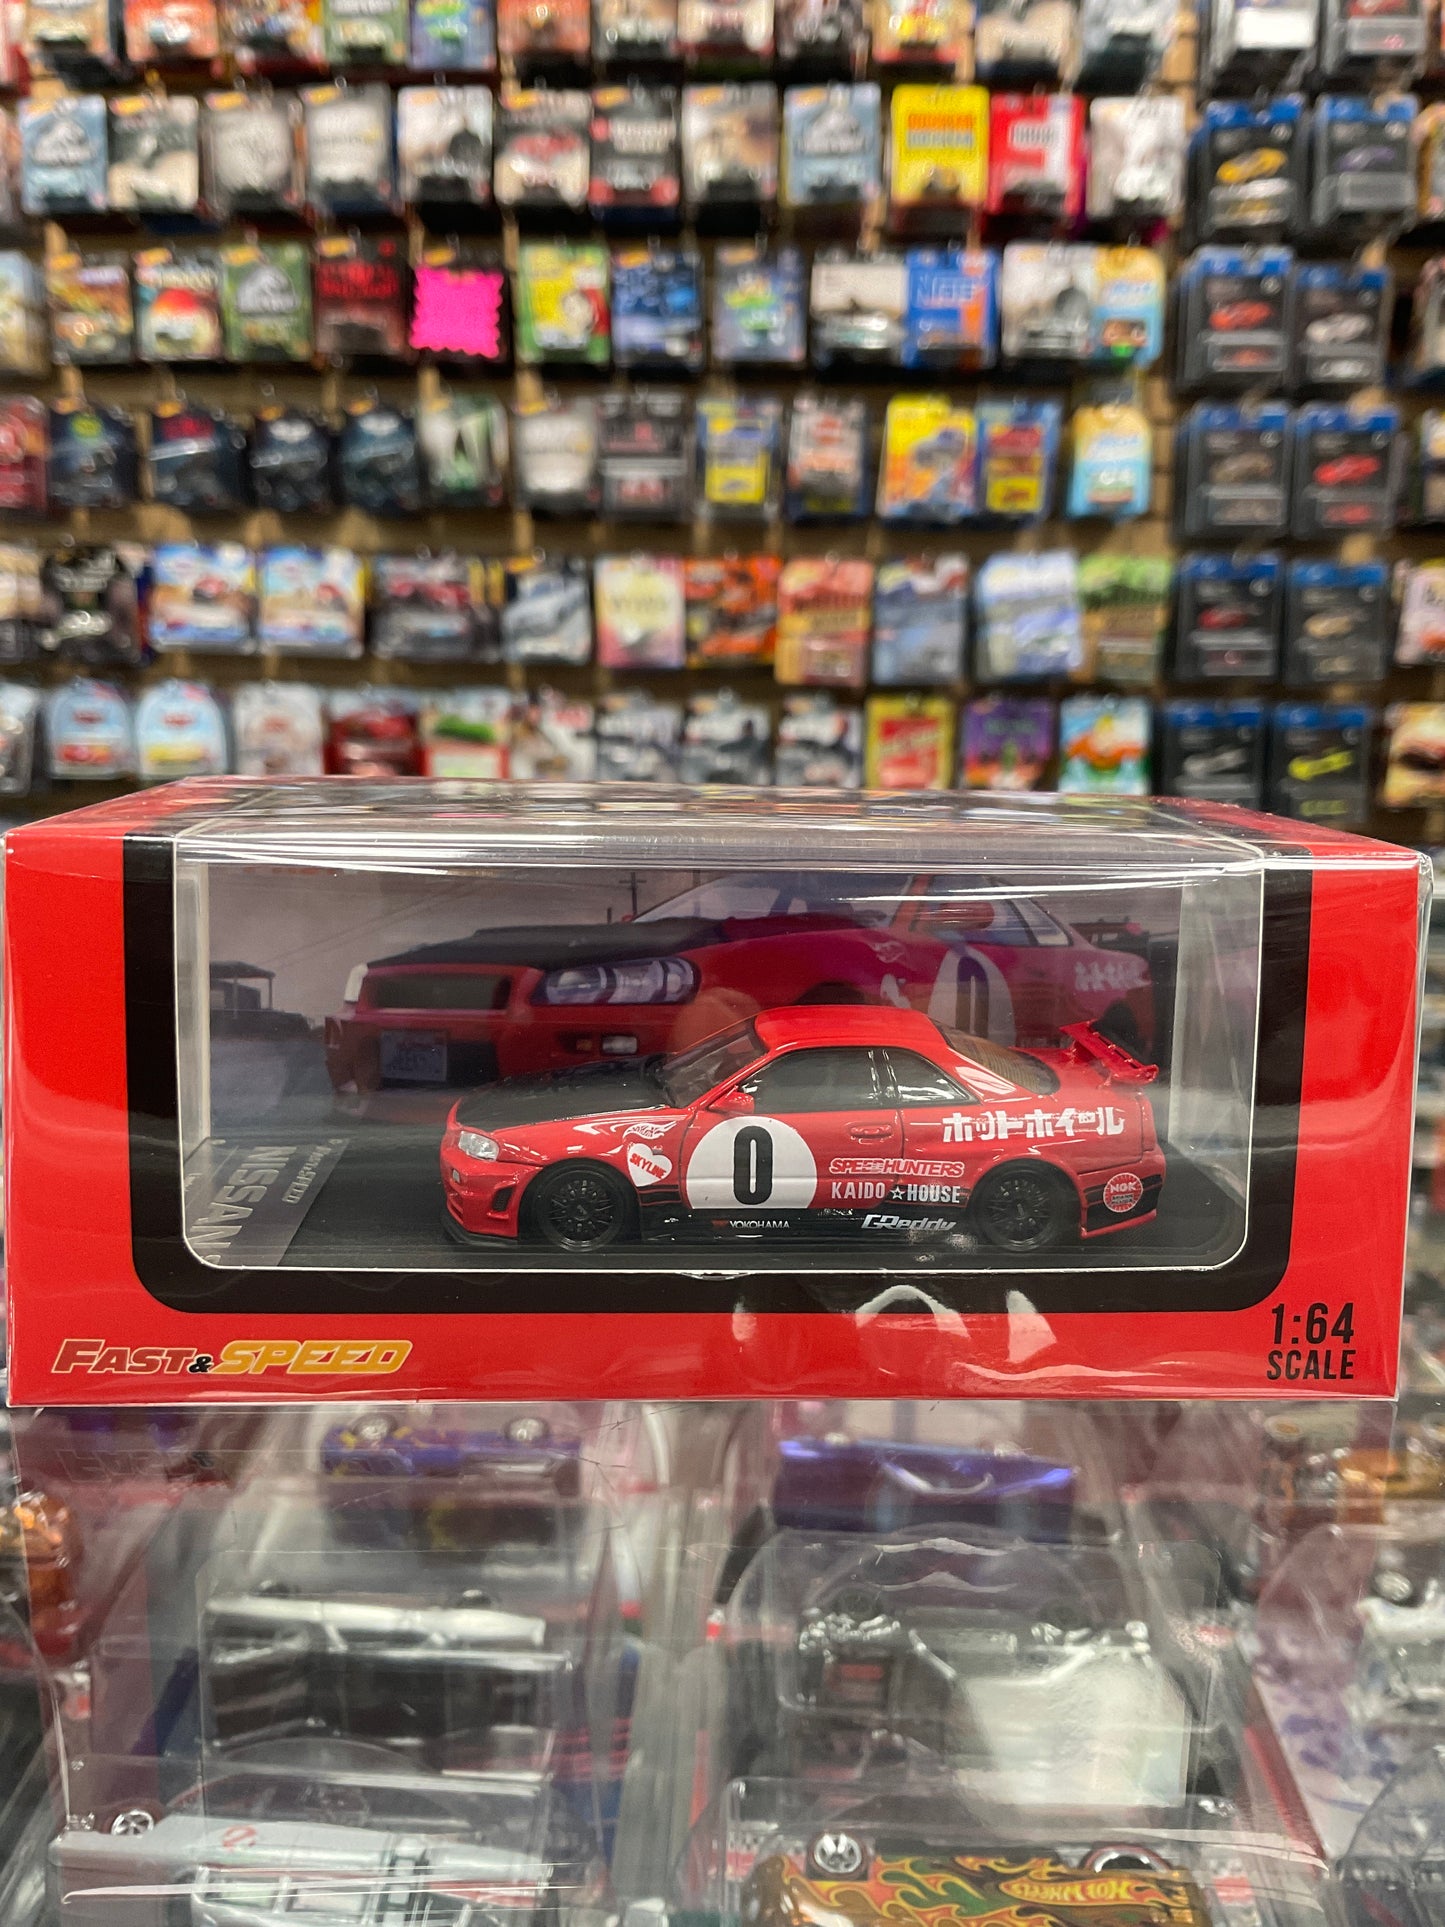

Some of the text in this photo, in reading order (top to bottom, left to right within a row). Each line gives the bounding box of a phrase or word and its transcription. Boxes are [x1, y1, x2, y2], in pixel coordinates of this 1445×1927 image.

[629, 1152, 667, 1180] SKYLINE
[733, 1125, 773, 1205] 0
[188, 1146, 298, 1249] NISSAN
[831, 1182, 961, 1203] KAIDO HOUSE
[729, 1220, 790, 1229] YOKOHAMA
[1271, 1302, 1354, 1344] 1:64
[1266, 1350, 1356, 1380] SCALE
